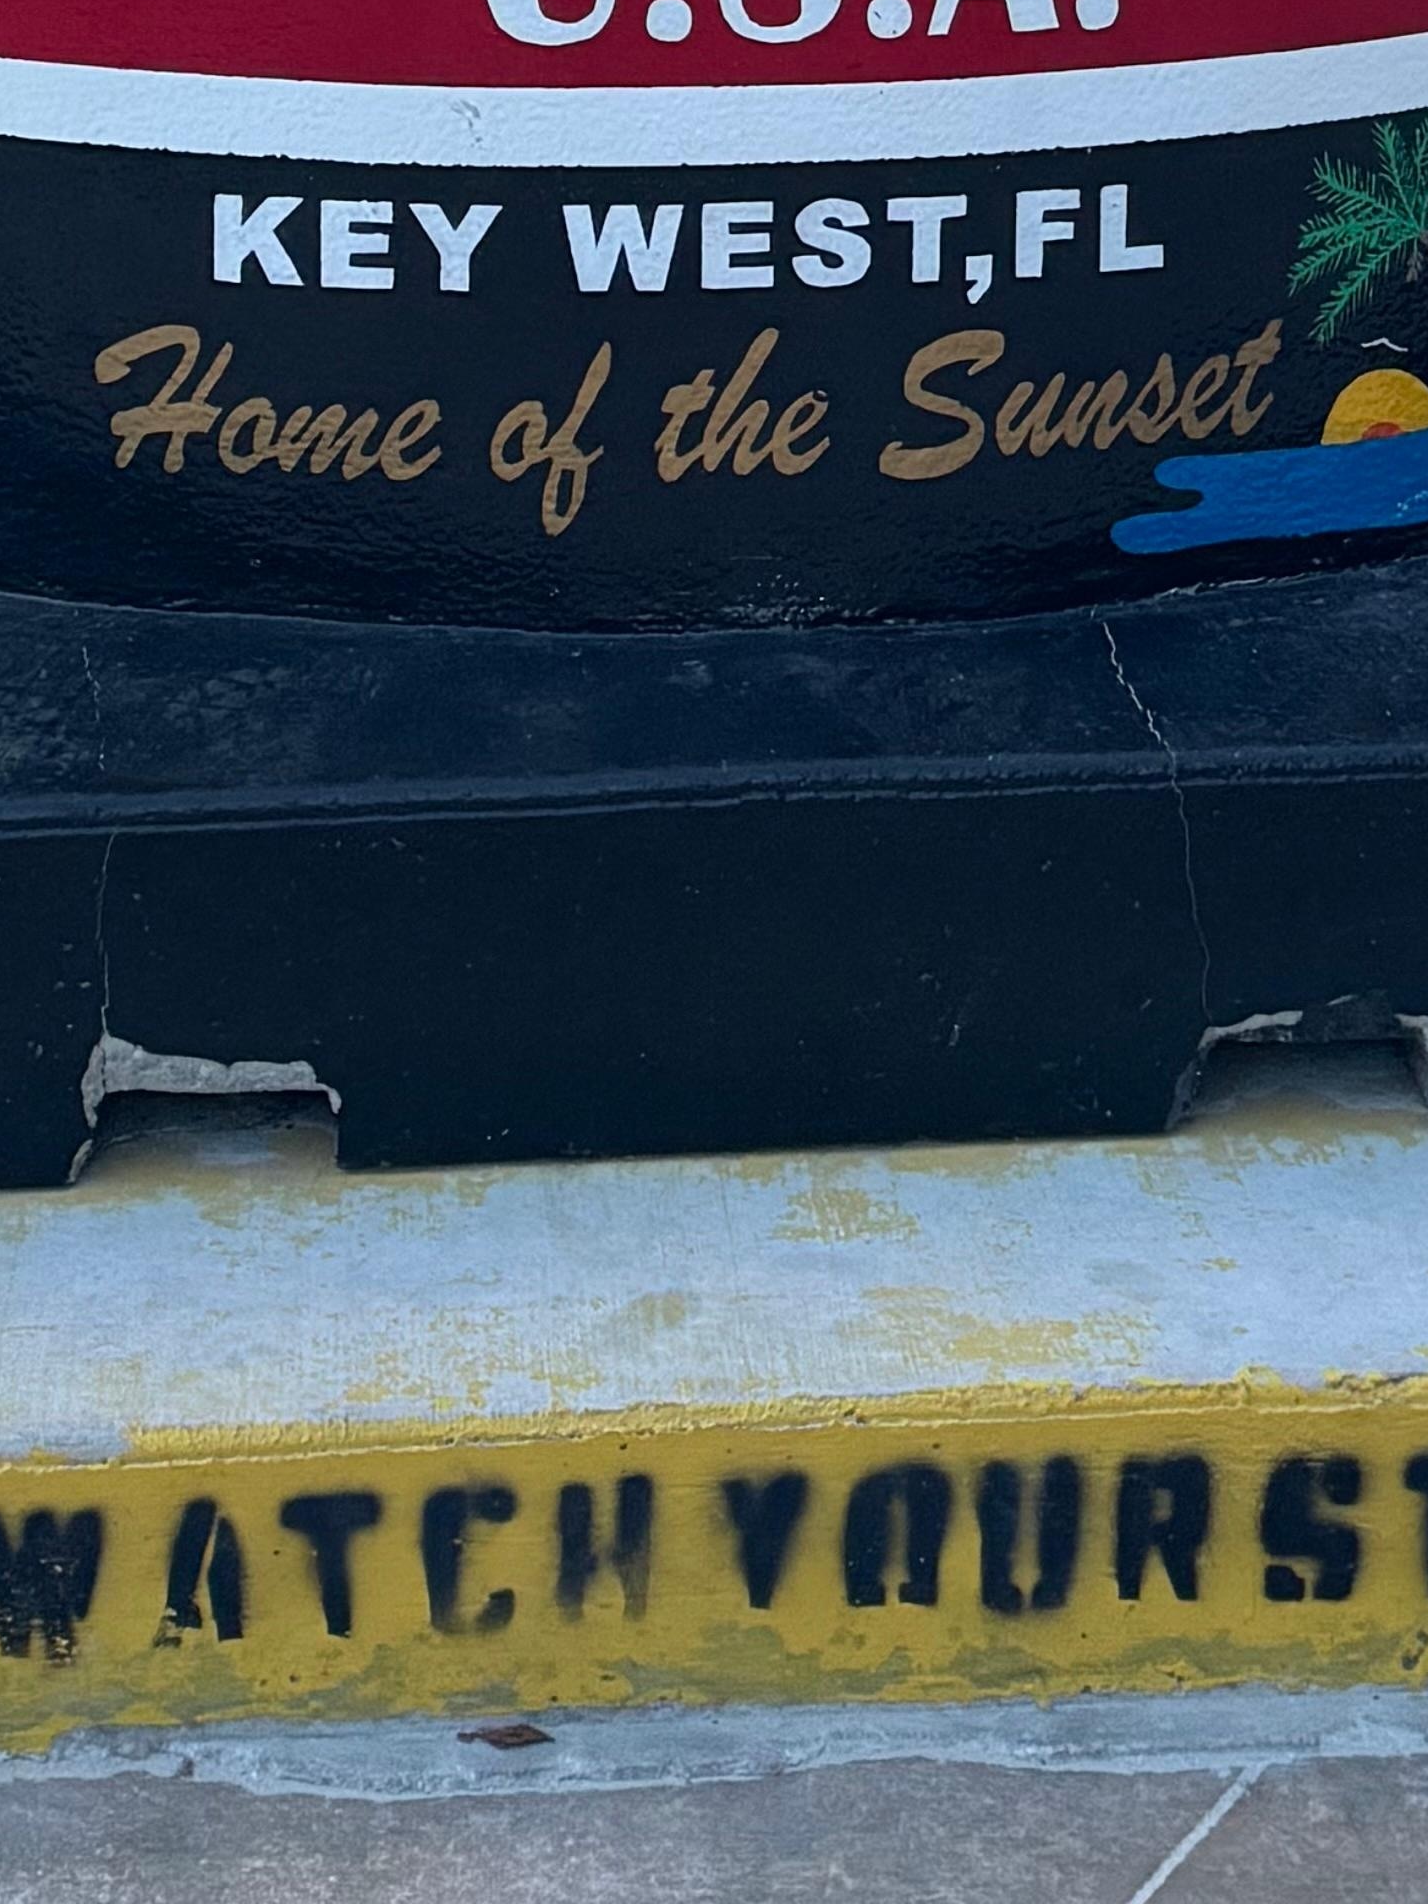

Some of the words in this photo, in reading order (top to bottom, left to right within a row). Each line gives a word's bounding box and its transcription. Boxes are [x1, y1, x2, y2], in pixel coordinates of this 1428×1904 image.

[213, 190, 503, 293] KEY
[93, 323, 443, 481] Home
[489, 339, 613, 538] of
[655, 326, 831, 482] the
[879, 317, 1284, 482] Sunset
